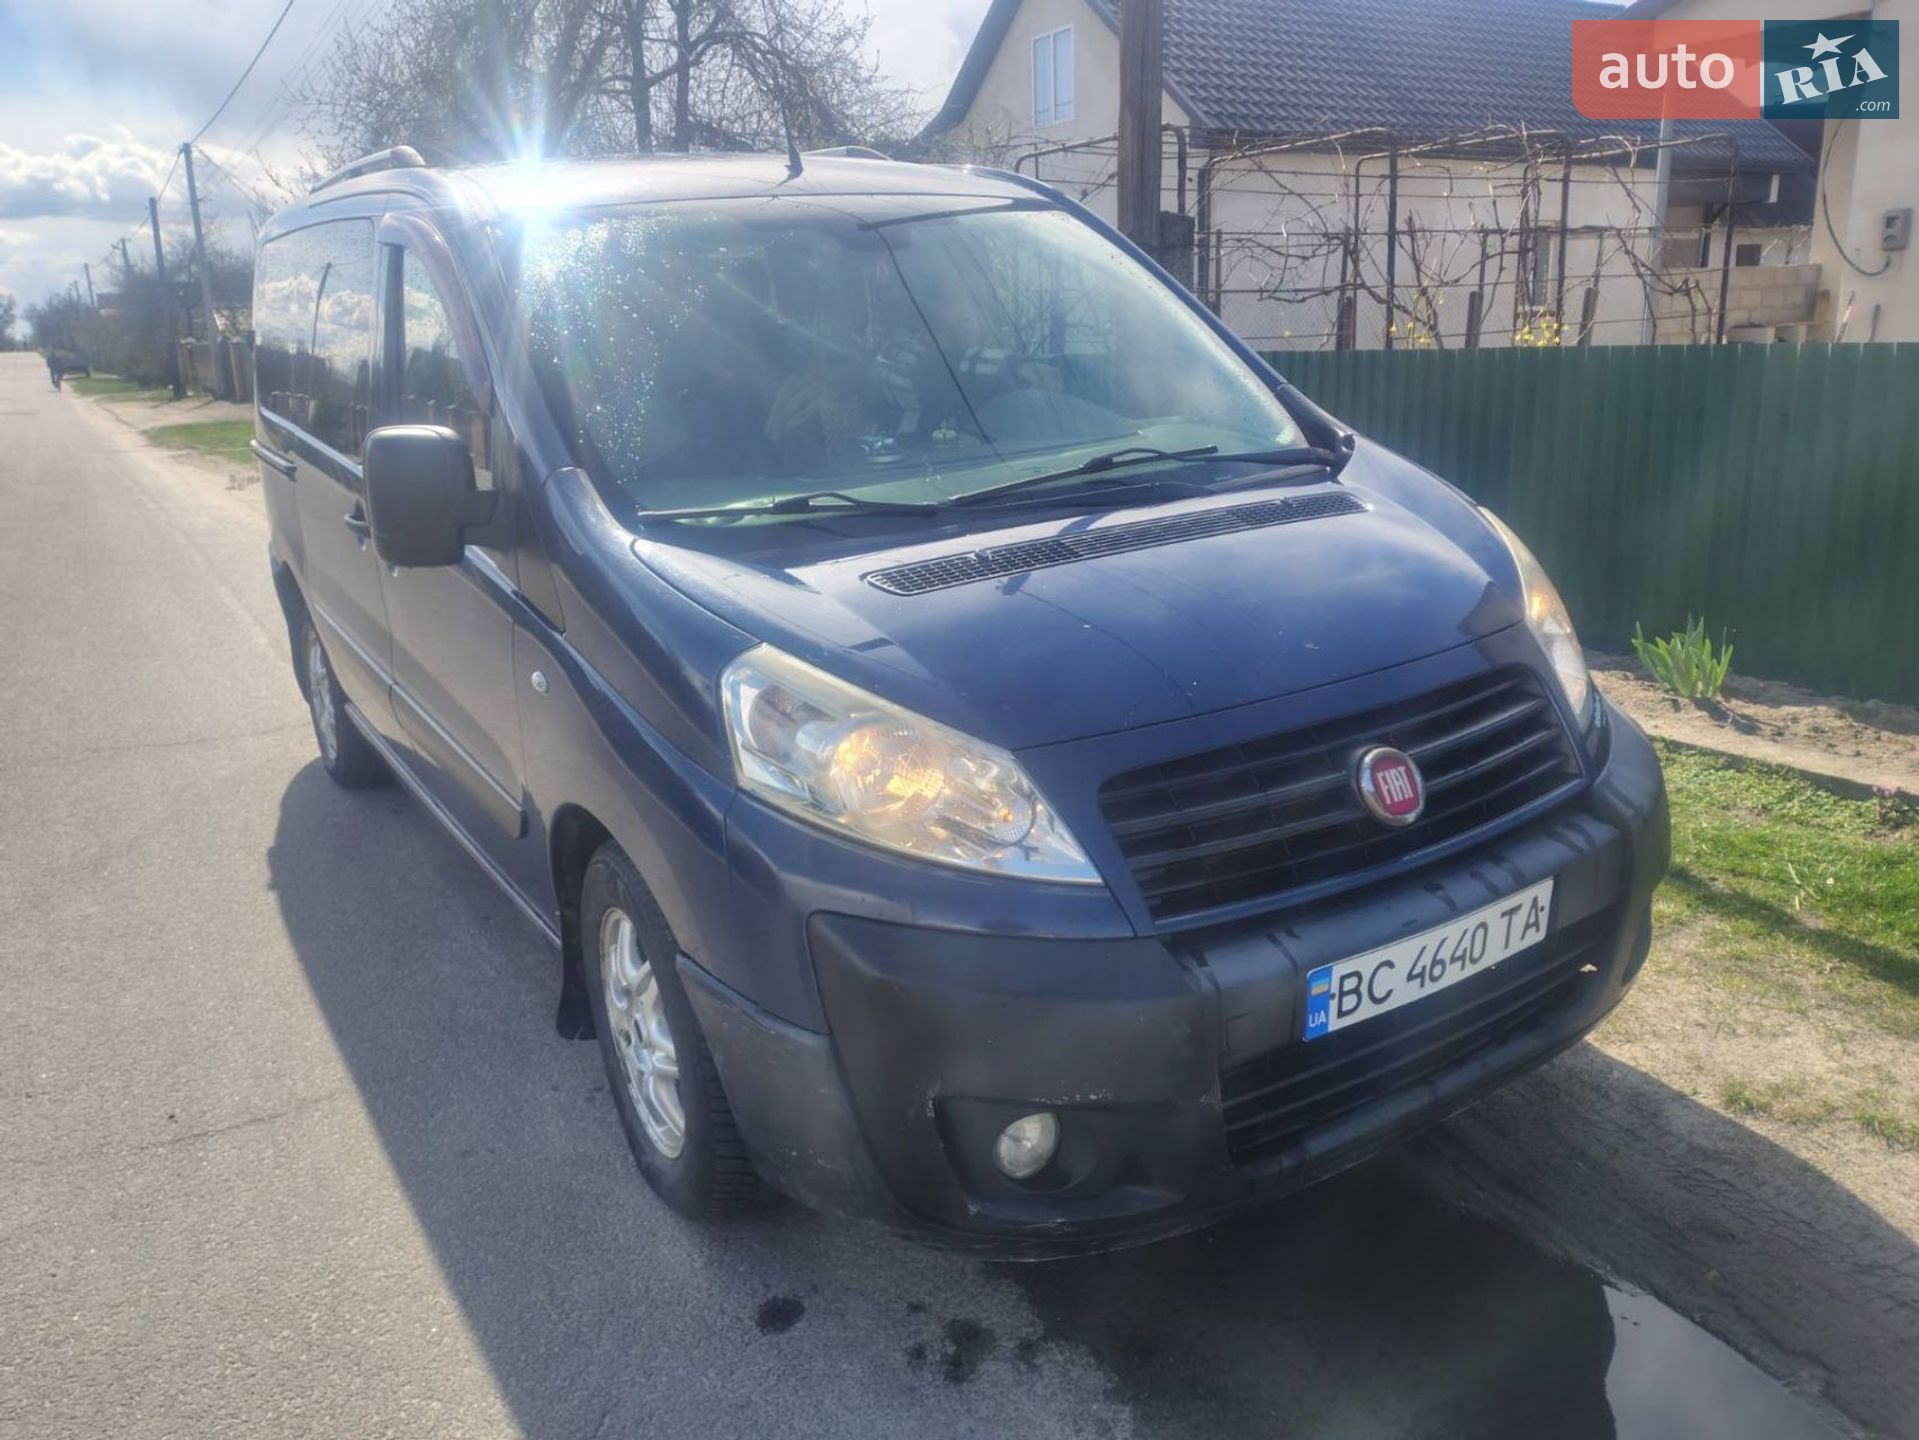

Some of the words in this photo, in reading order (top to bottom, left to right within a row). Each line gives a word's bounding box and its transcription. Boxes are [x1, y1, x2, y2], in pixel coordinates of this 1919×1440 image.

[1376, 765, 1414, 805] FIAT
[1336, 959, 1396, 1019] BC
[1406, 921, 1489, 989] 4640
[1501, 895, 1542, 949] TA
[1308, 1009, 1327, 1028] UA
